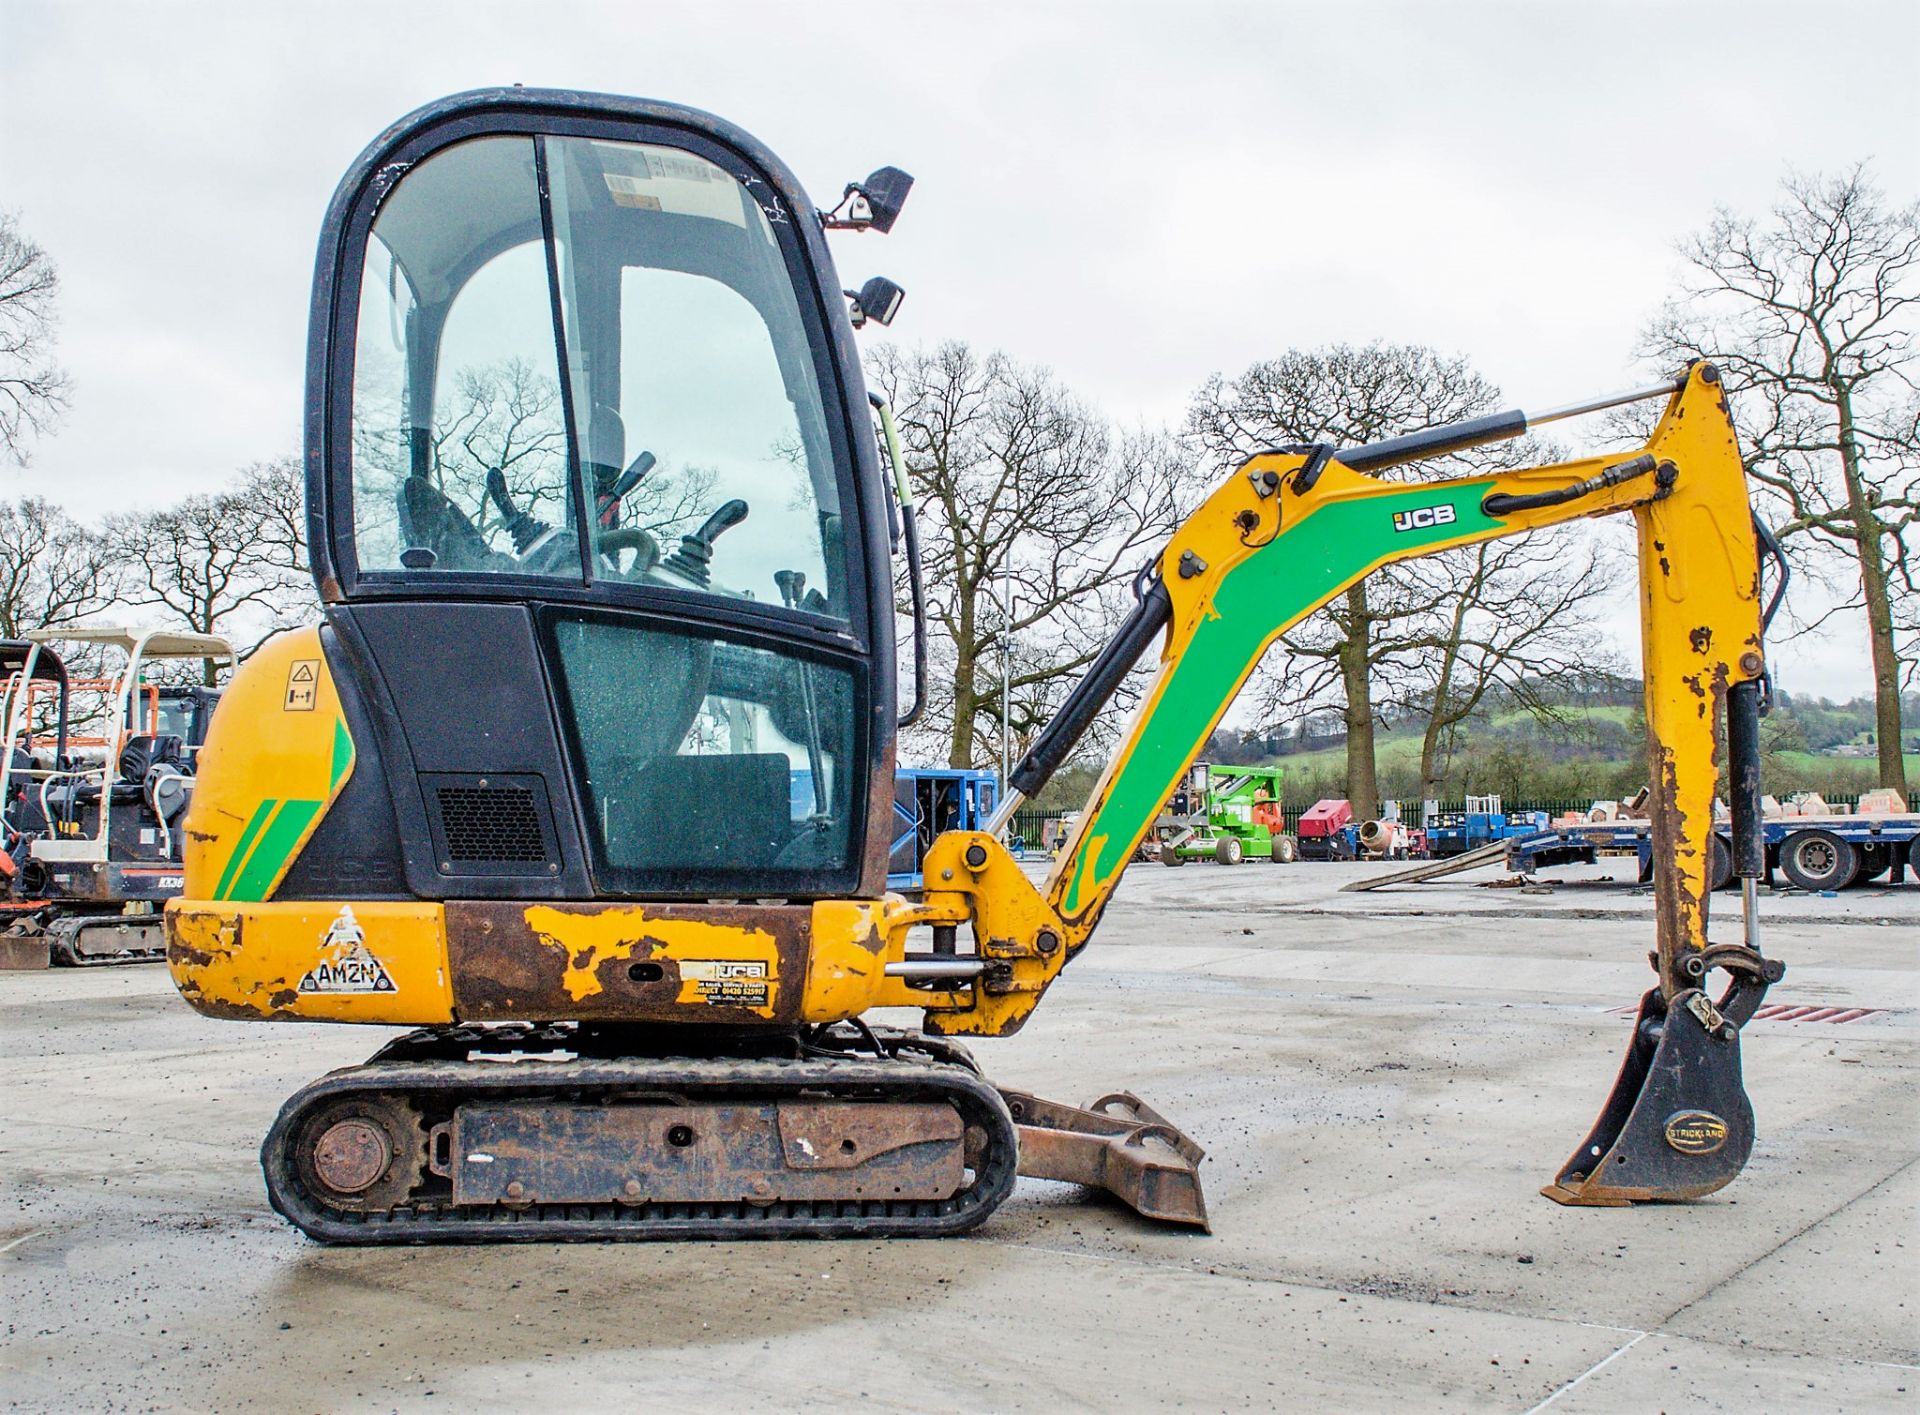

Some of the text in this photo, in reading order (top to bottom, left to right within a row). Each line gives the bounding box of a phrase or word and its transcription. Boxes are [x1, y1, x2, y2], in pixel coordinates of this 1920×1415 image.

[1394, 504, 1456, 531] JCB
[318, 963, 375, 984] AM2N
[719, 965, 761, 978] JCB
[722, 987, 742, 995] 01420
[743, 987, 766, 996] 525917
[1670, 1129, 1724, 1140] STRICKLAND
